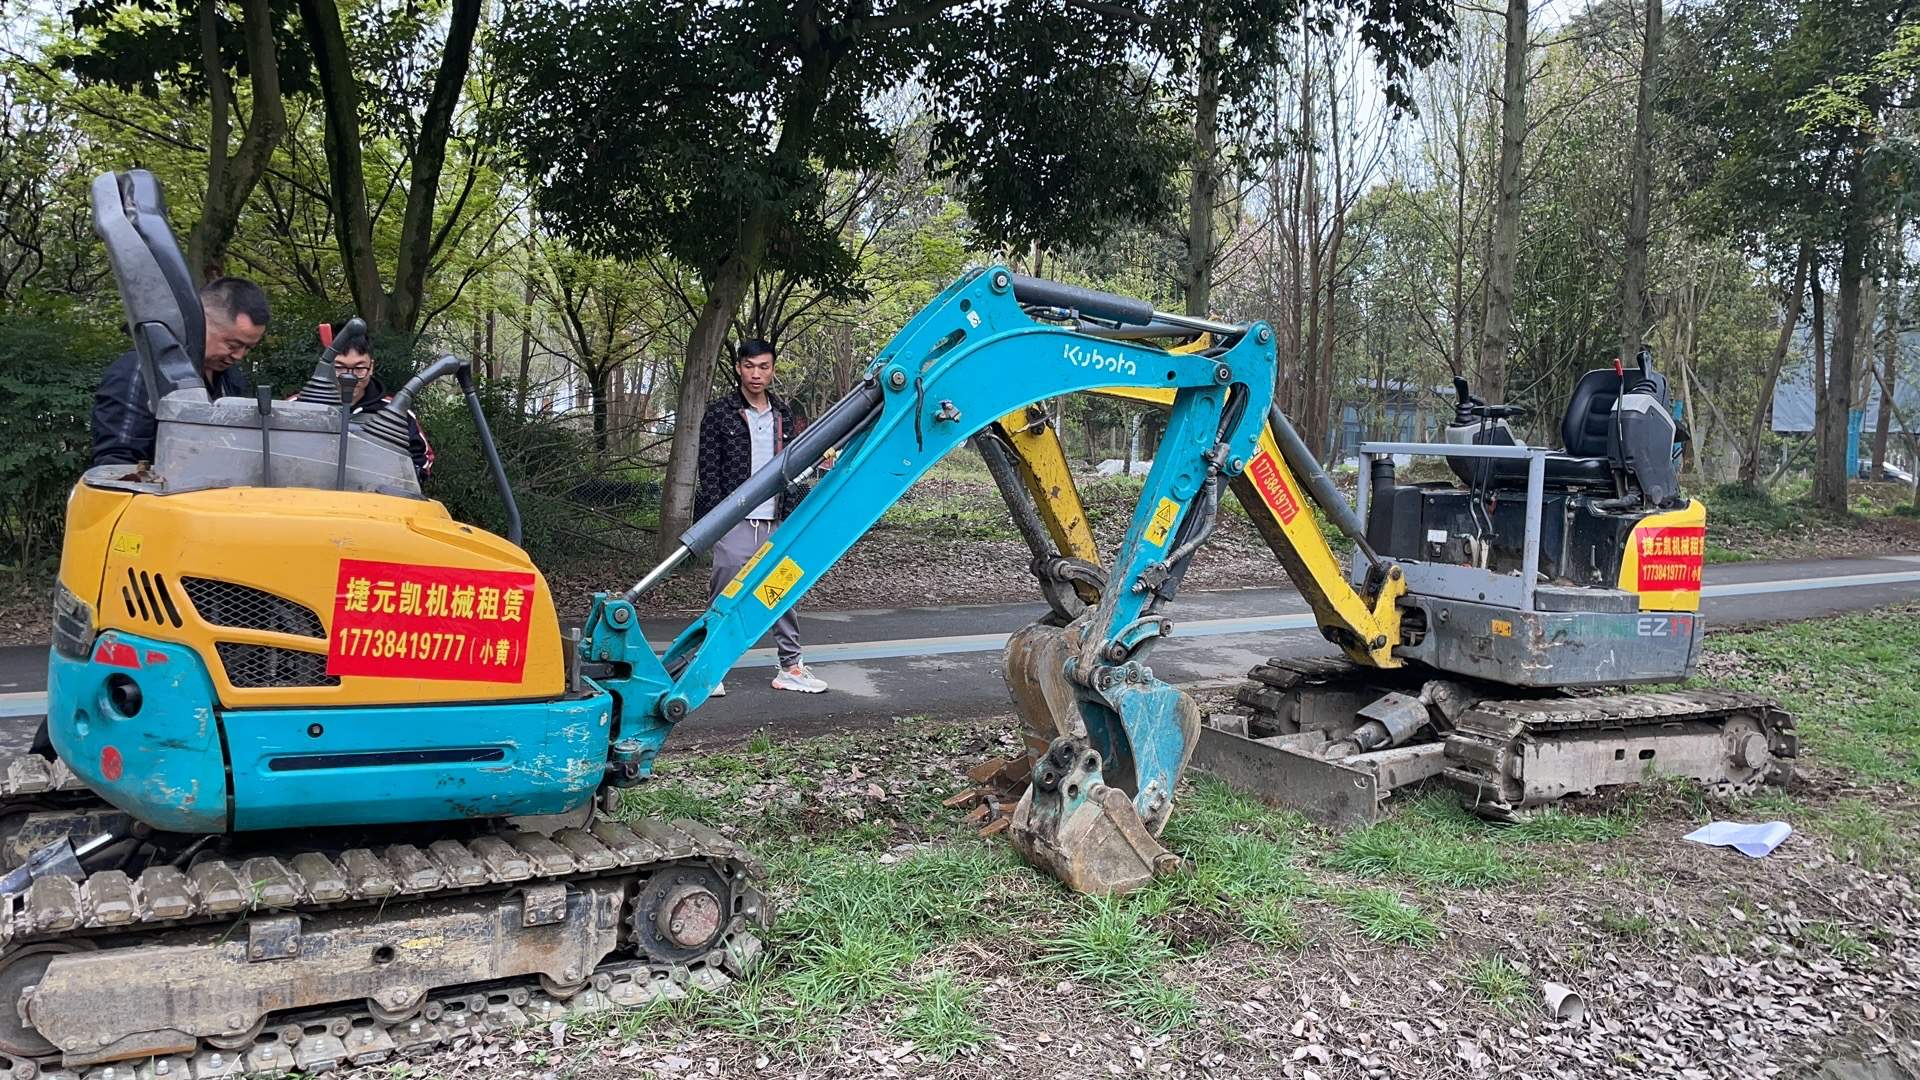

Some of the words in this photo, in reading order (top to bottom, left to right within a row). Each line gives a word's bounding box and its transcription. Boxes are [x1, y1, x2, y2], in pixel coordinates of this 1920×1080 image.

[1063, 343, 1137, 376] Kubota
[1255, 458, 1296, 520] 17738419777
[344, 577, 525, 622] 捷元凯机械租赁
